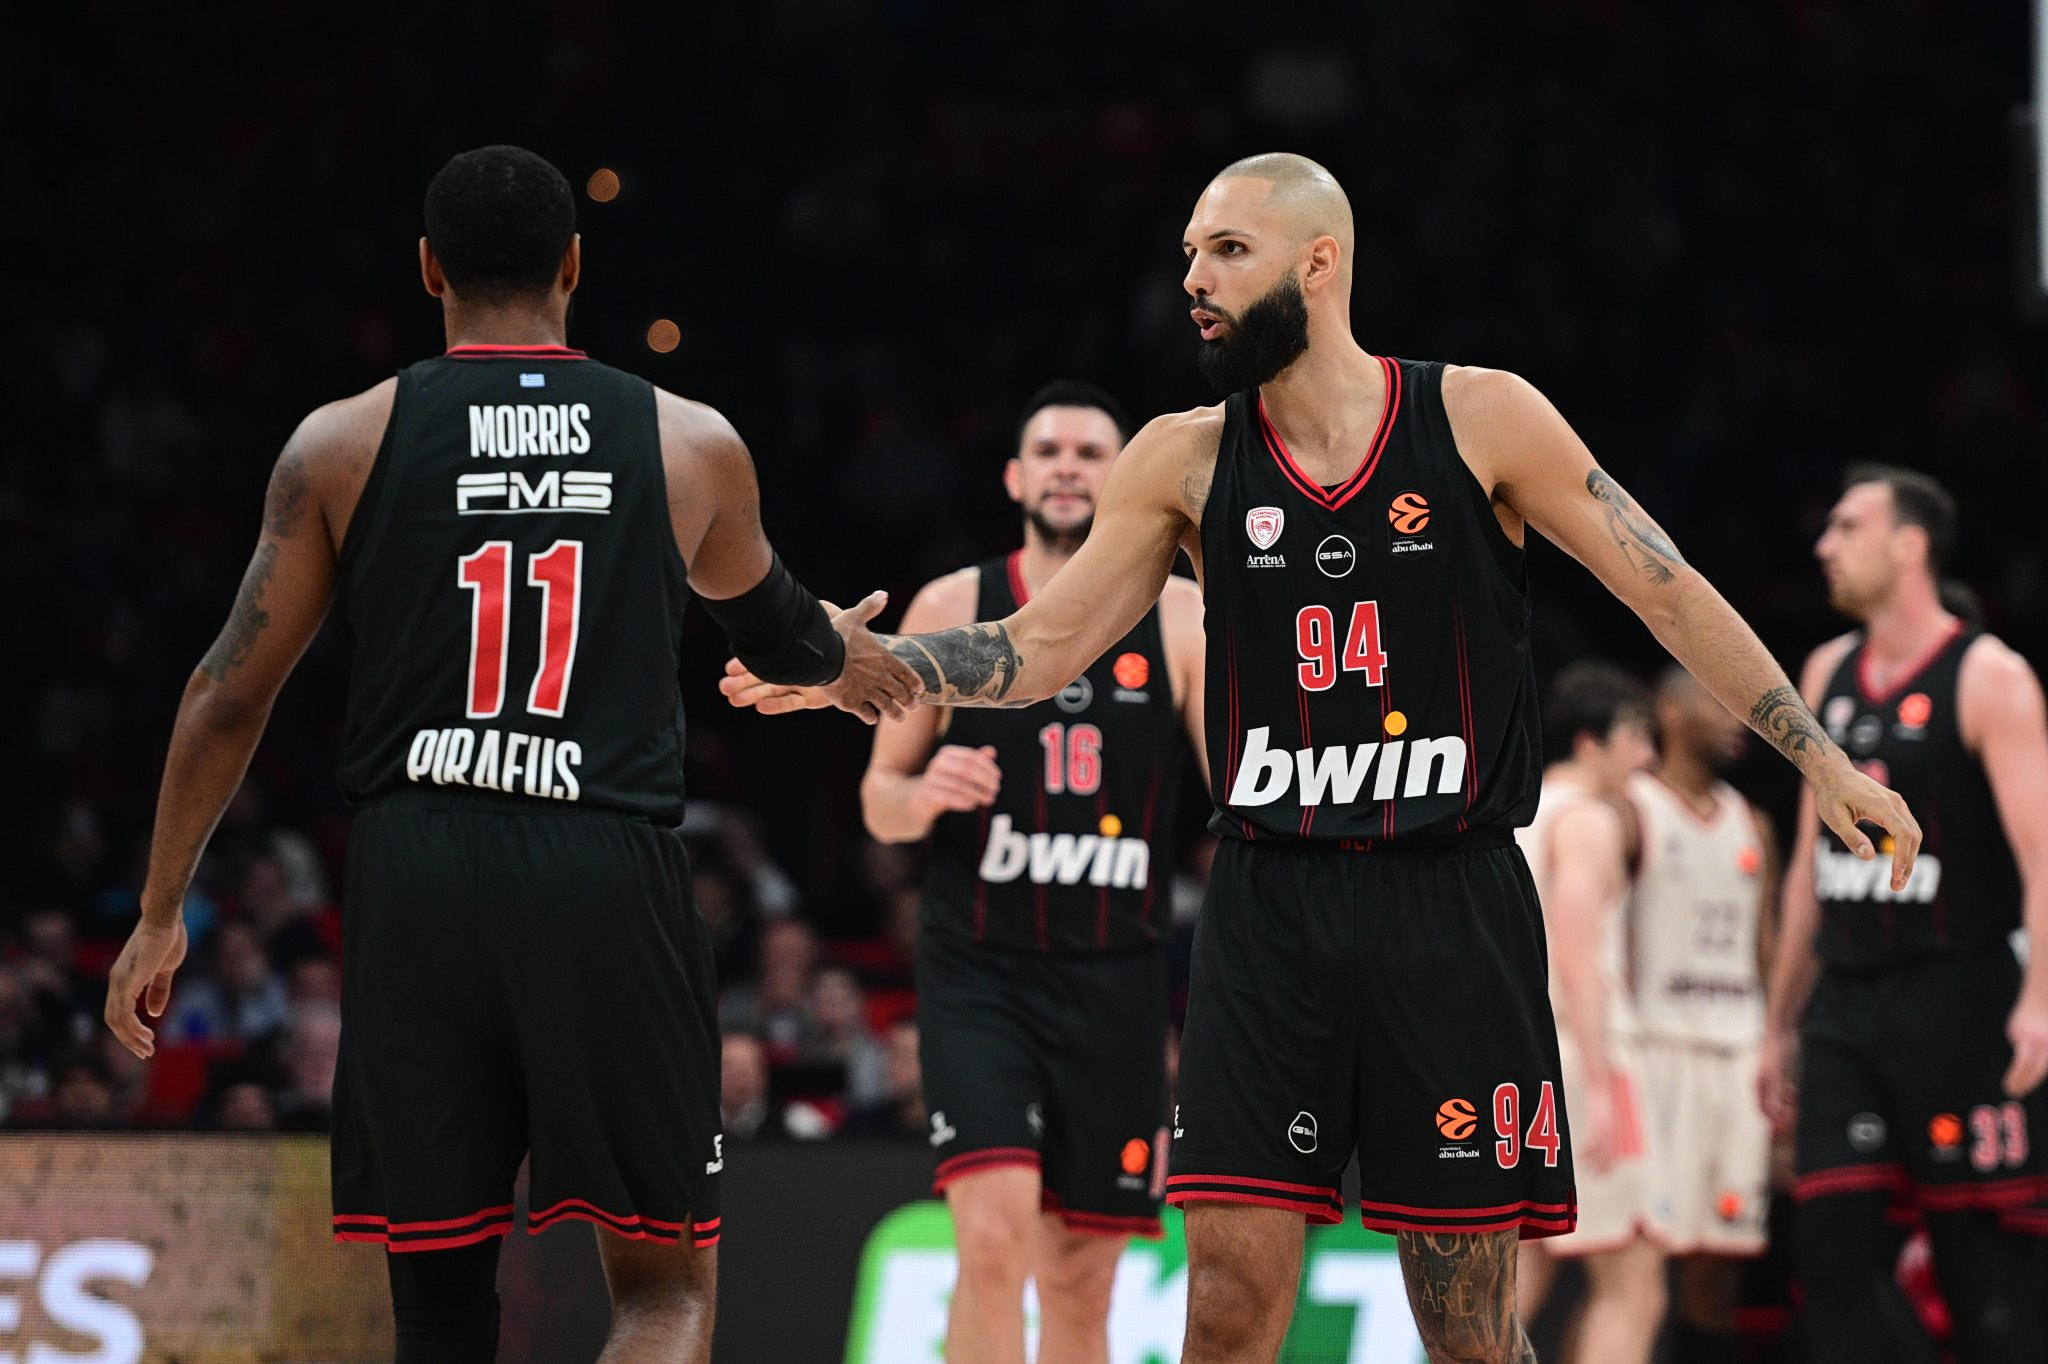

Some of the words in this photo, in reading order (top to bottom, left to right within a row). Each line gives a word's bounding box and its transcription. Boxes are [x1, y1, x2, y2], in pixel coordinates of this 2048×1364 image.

[469, 403, 591, 458] MORRIS
[457, 471, 612, 514] FMS
[1319, 551, 1352, 560] GSA
[1409, 542, 1433, 551] dhabi
[458, 539, 583, 719] 11
[1296, 600, 1387, 692] 94
[1039, 722, 1102, 795] 16
[1229, 711, 1466, 806] bwin
[979, 814, 1150, 889] bwin
[1439, 1150, 1455, 1158] abu
[1456, 1149, 1480, 1158] dhabi
[1492, 1080, 1561, 1169] 94
[1969, 1101, 2028, 1171] 33
